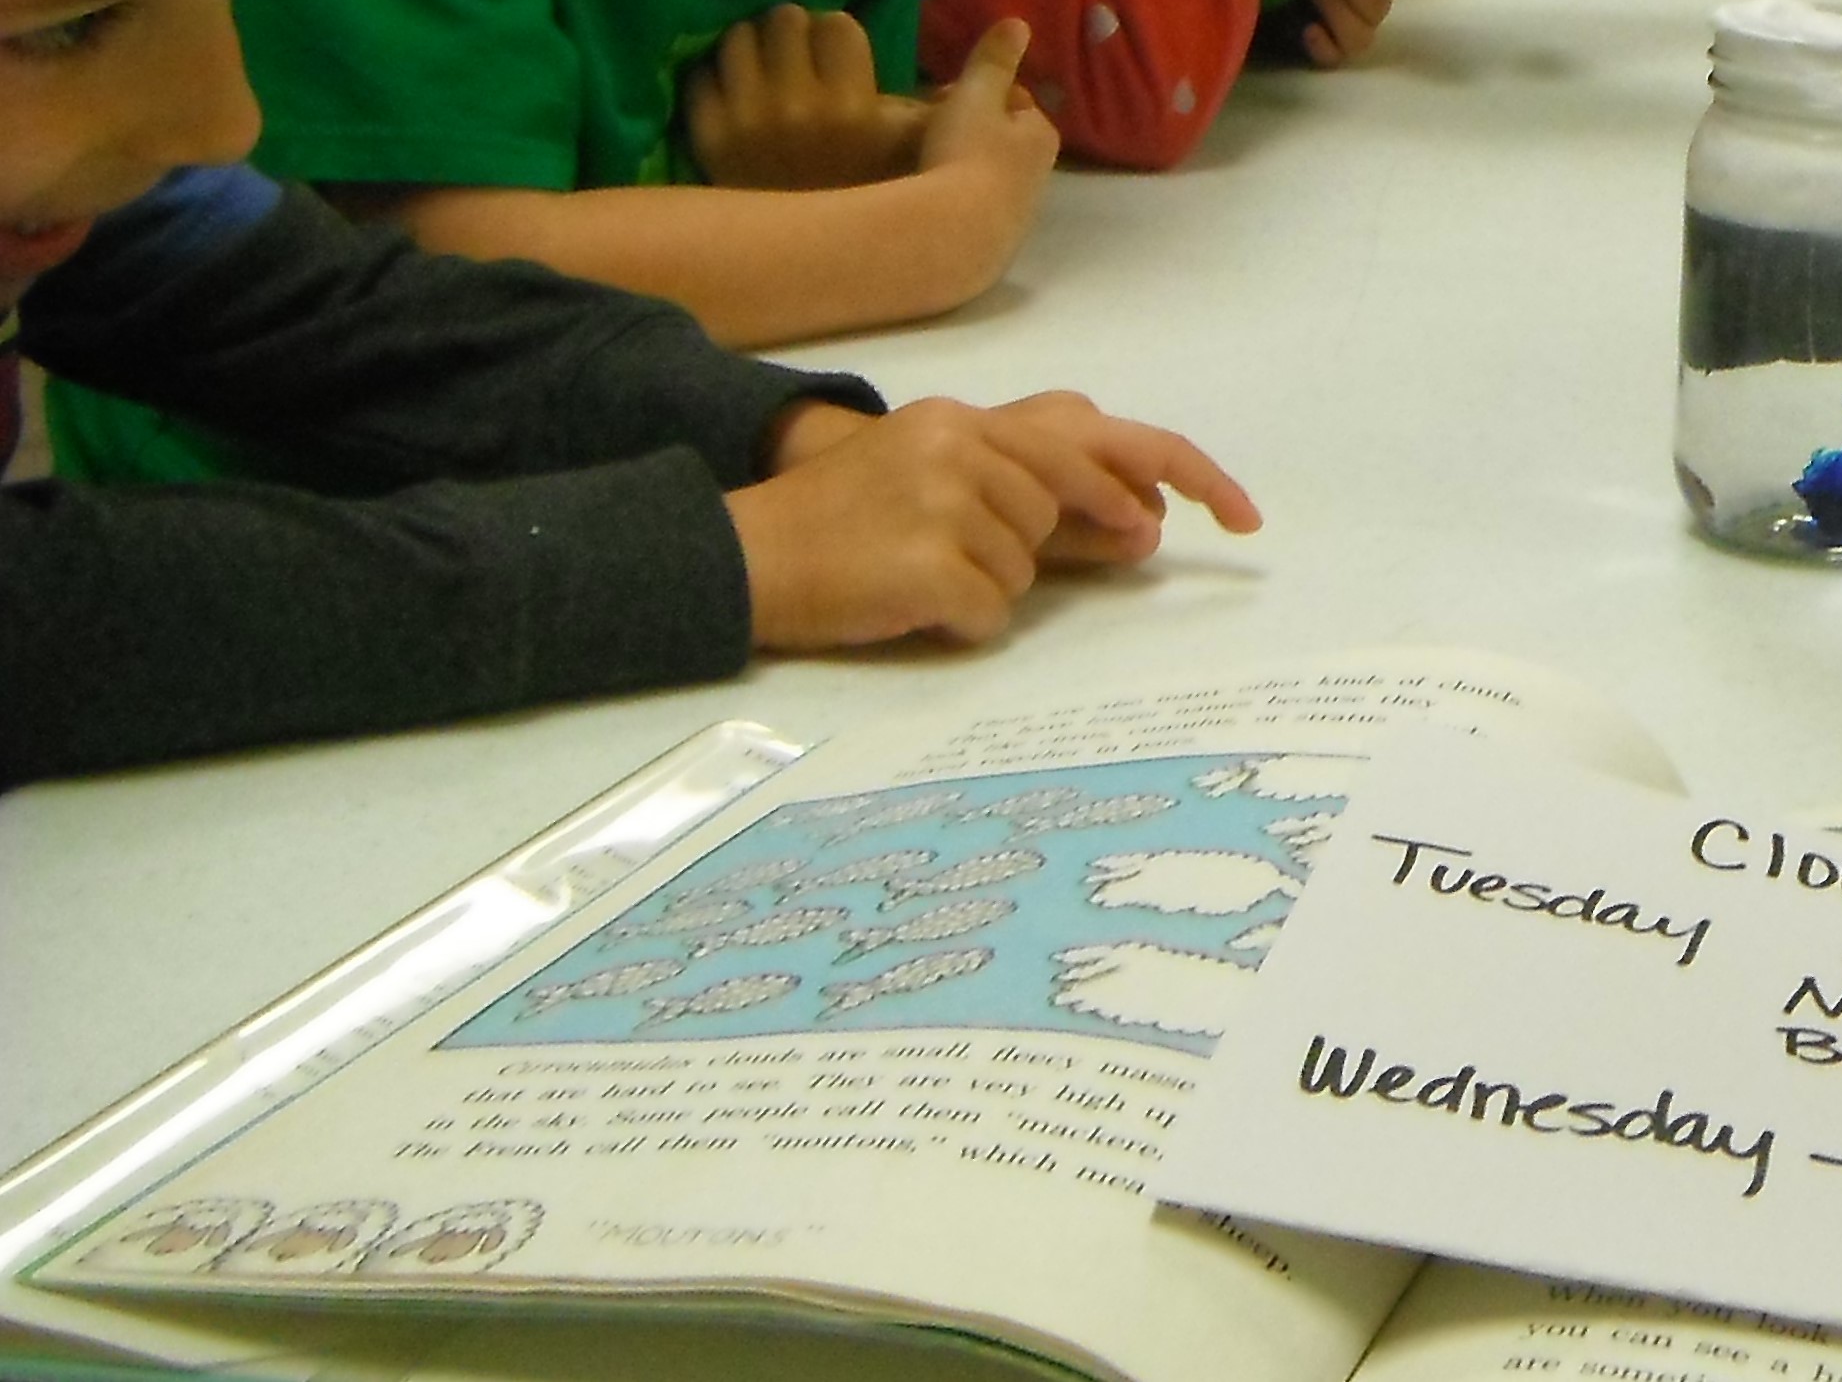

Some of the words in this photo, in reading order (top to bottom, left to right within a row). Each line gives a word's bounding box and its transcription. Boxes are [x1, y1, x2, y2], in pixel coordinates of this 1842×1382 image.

[1266, 692, 1367, 708] because
[1381, 691, 1438, 711] they
[1318, 672, 1385, 688] kinds
[1398, 674, 1428, 688] of
[1372, 835, 1711, 967] Tuesday
[707, 1047, 804, 1066] clouds
[817, 1051, 867, 1062] are
[991, 1046, 1082, 1072] fleecy
[1099, 1062, 1196, 1092] masse
[462, 1087, 526, 1104] that
[537, 1088, 588, 1102] are
[599, 1079, 678, 1099] hard
[684, 1080, 719, 1095] to
[808, 1072, 883, 1093] They
[898, 1075, 951, 1089] are
[968, 1077, 1038, 1100] very
[1054, 1083, 1126, 1112] high
[424, 1118, 456, 1131] in
[469, 1112, 521, 1130] the
[606, 1108, 692, 1126] Some
[700, 1101, 810, 1125] people
[819, 1098, 886, 1117] call
[898, 1101, 982, 1126] them
[1298, 1034, 1775, 1199] Wednesday
[393, 1141, 452, 1159] The
[462, 1139, 571, 1159] French
[584, 1134, 649, 1156] call
[656, 1132, 739, 1152] them
[959, 1143, 1058, 1174] which
[1548, 1284, 1649, 1310] When
[1674, 1298, 1734, 1326] you
[1757, 1311, 1828, 1344] look
[1501, 1356, 1562, 1371] are
[1517, 1321, 1590, 1340] you
[1610, 1327, 1674, 1349] can
[1694, 1339, 1751, 1363] see
[1769, 1357, 1791, 1375] a
